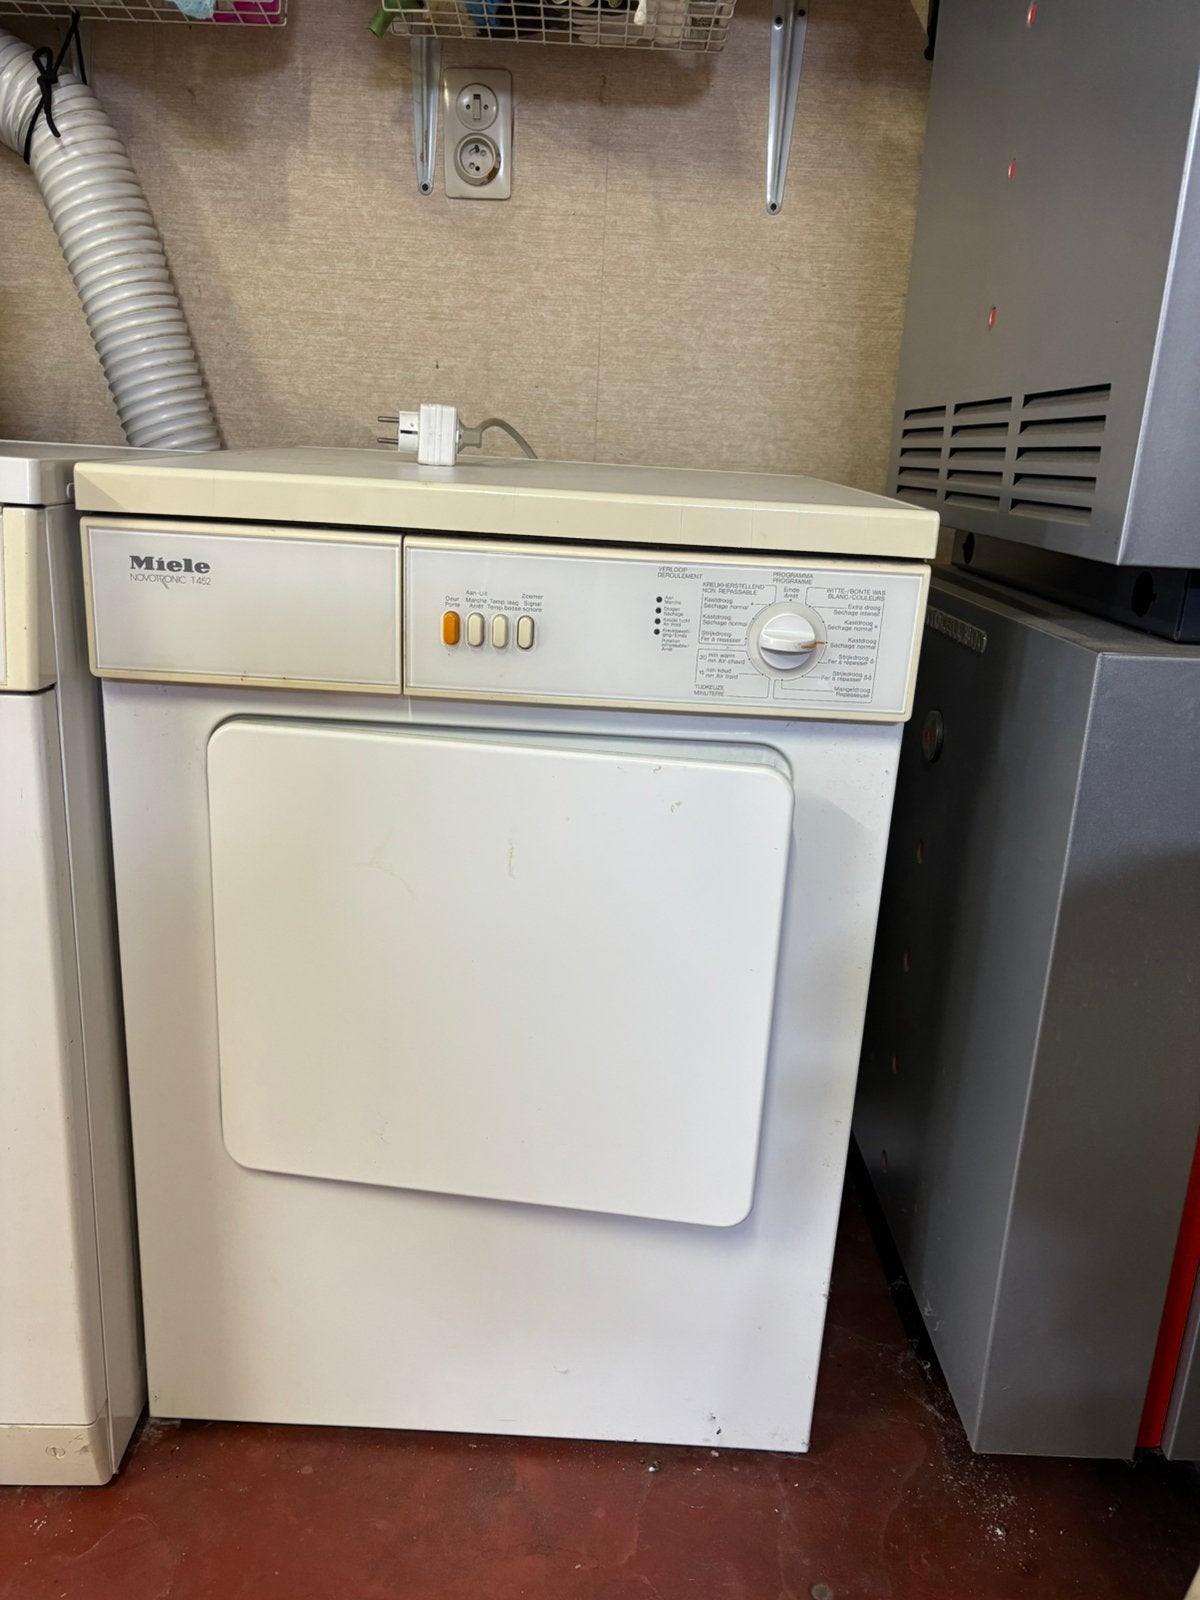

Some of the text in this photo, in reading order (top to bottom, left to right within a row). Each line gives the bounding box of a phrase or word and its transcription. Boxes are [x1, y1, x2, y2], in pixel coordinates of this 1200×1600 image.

[129, 555, 211, 574] Miele
[658, 572, 703, 580] DEROULEMENT
[130, 573, 187, 590] NOVOTRONIC
[703, 582, 765, 590] KREUKHERSTELLEND
[834, 686, 871, 694] Mangeldroog
